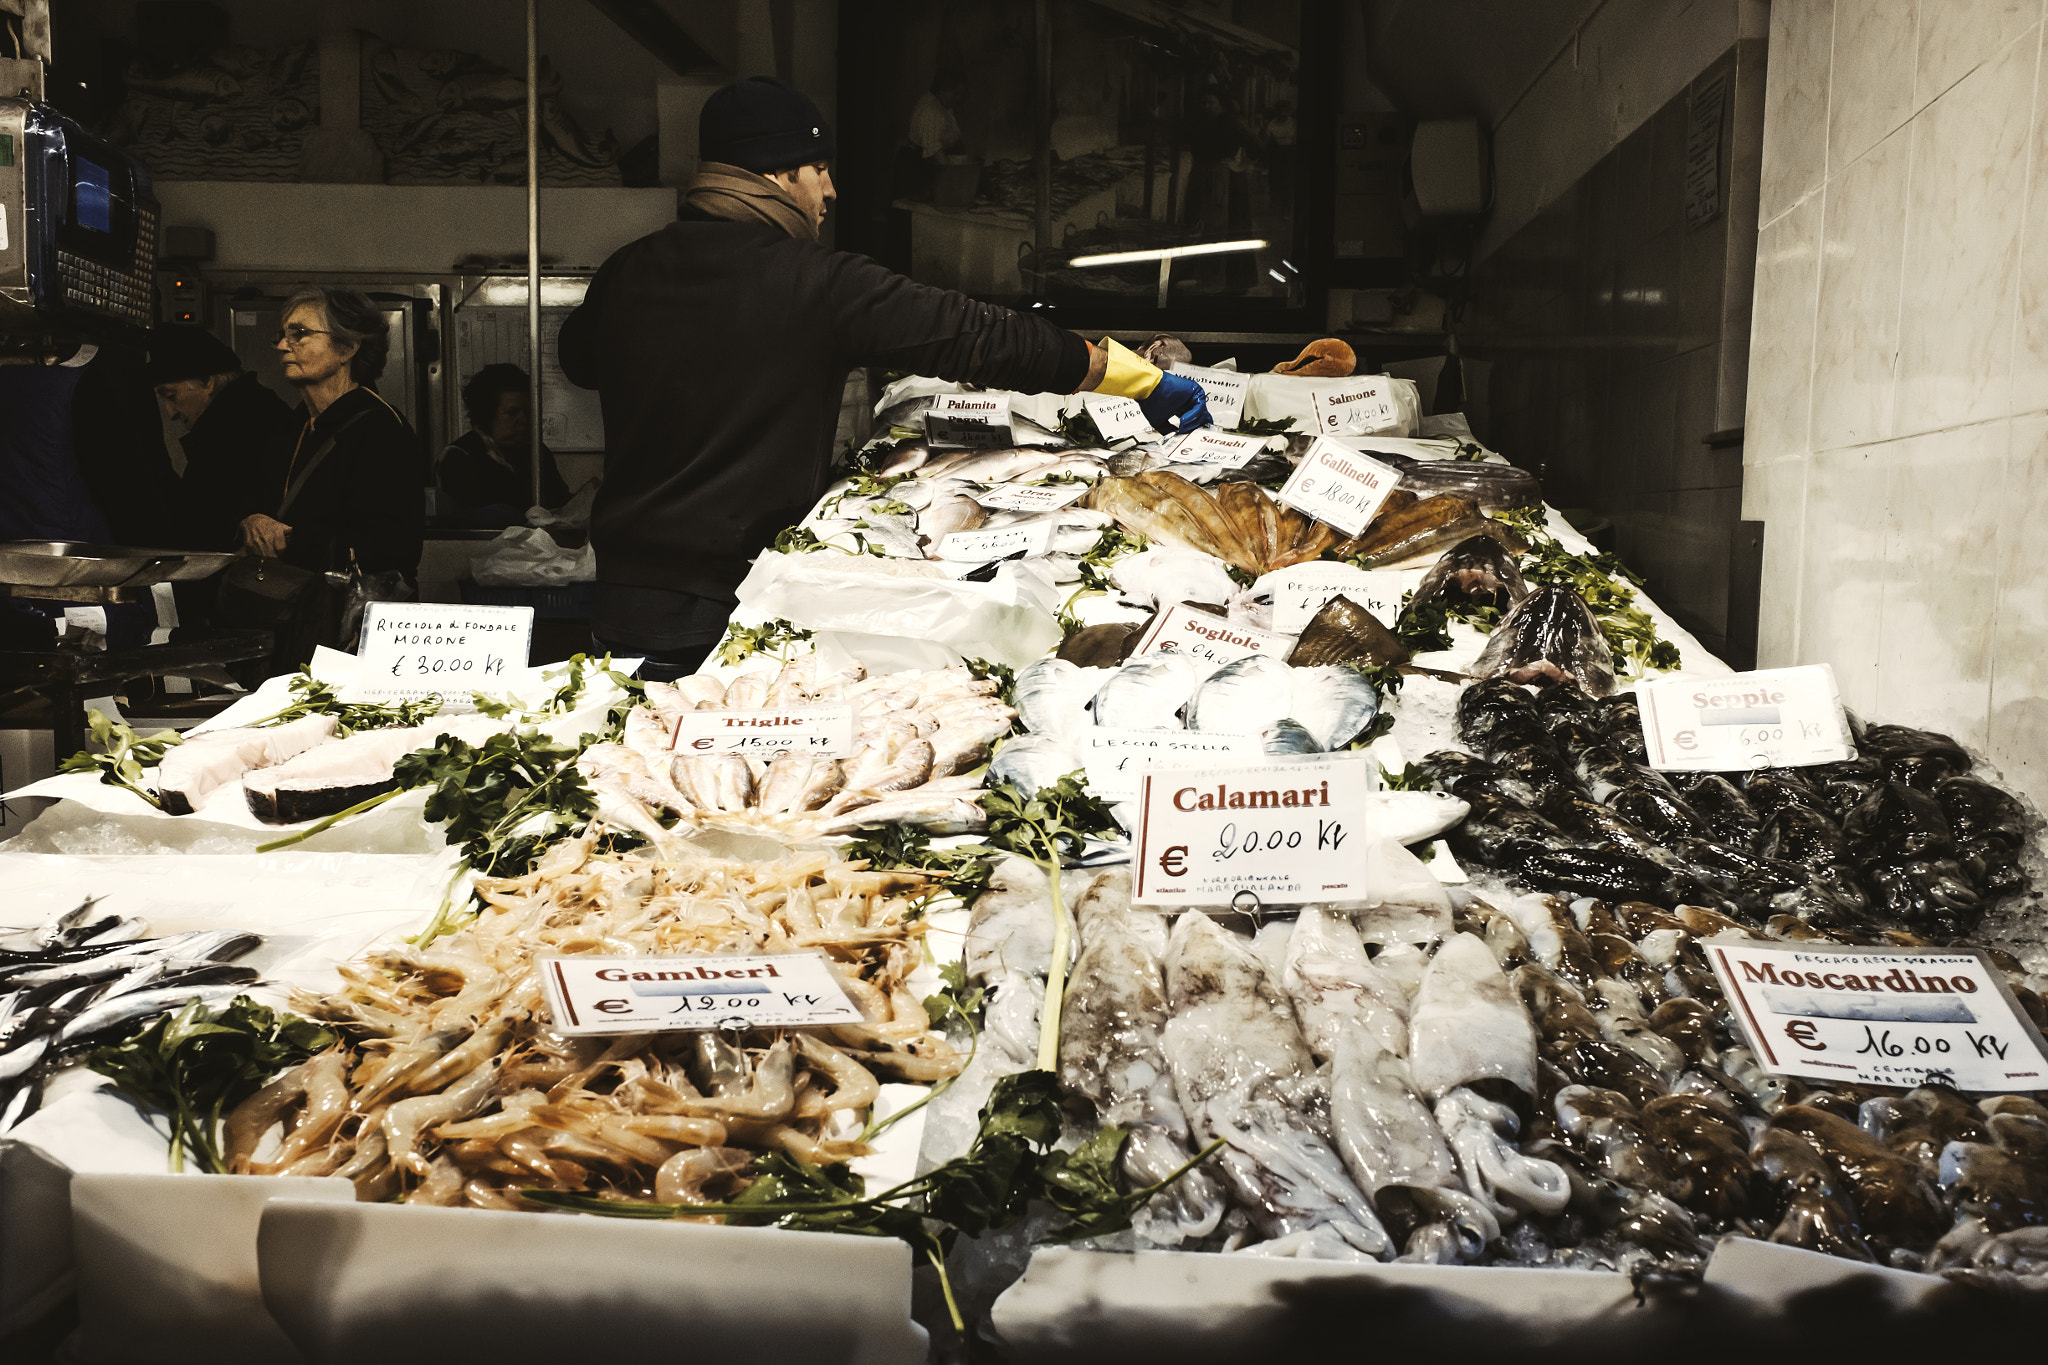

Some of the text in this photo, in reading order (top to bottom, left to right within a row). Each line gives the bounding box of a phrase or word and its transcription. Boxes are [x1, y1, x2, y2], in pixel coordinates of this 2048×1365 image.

[1328, 389, 1376, 406] Salmone
[946, 400, 996, 410] Palamita
[1099, 401, 1135, 413] BACCAL
[1328, 414, 1338, 426] €
[1200, 435, 1247, 448] Saraghi
[1180, 447, 1193, 456] €
[1319, 452, 1379, 490] Gallinella
[1300, 478, 1316, 493] €
[1020, 489, 1057, 497] Orate
[376, 618, 442, 632] RICCIOLA
[465, 621, 517, 632] FONDALE
[394, 635, 466, 645] MORONE
[1184, 619, 1260, 650] Sogliole
[1160, 640, 1179, 653] €
[391, 655, 406, 677] €
[418, 655, 473, 675] 30.00
[1692, 687, 1785, 709] Seppie
[721, 716, 804, 727] Triglie
[690, 738, 715, 750] €
[1092, 738, 1231, 751] LECCIA STELLA
[1672, 730, 1698, 750] €
[1173, 780, 1331, 812] Calamari
[1159, 845, 1189, 877] €
[1212, 822, 1302, 862] 20.00
[1794, 954, 1859, 964] PESCATO
[594, 963, 782, 982] Gamberi
[1737, 960, 1979, 994] Moscardino
[592, 998, 634, 1014] €
[1783, 1019, 1828, 1052] €
[1856, 1025, 1951, 1058] 16.00
[1857, 1073, 1895, 1084] MAR
